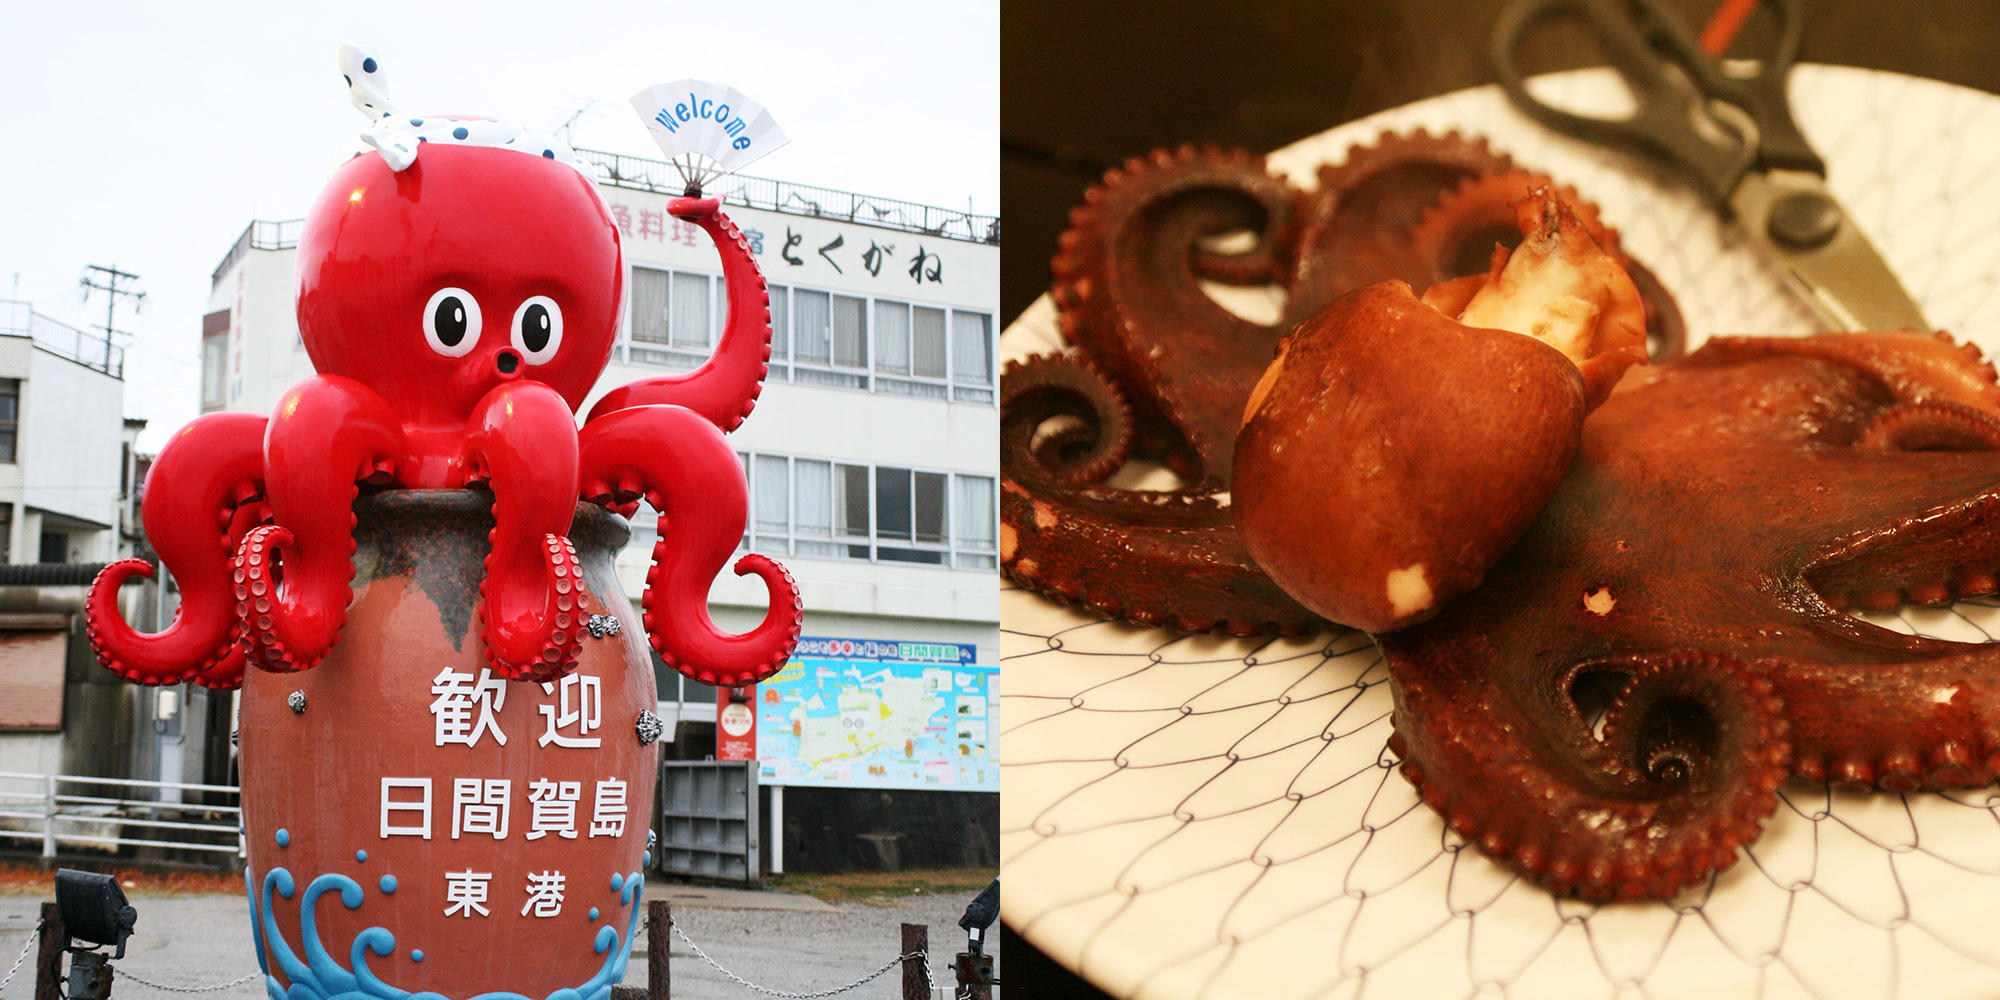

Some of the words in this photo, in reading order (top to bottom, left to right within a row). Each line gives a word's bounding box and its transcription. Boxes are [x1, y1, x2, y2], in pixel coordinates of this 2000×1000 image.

[655, 92, 751, 150] Welcome
[781, 225, 943, 285] とくがね
[429, 666, 602, 749] 歓迎
[379, 776, 628, 841] 日間賀島
[443, 869, 566, 918] 東港
